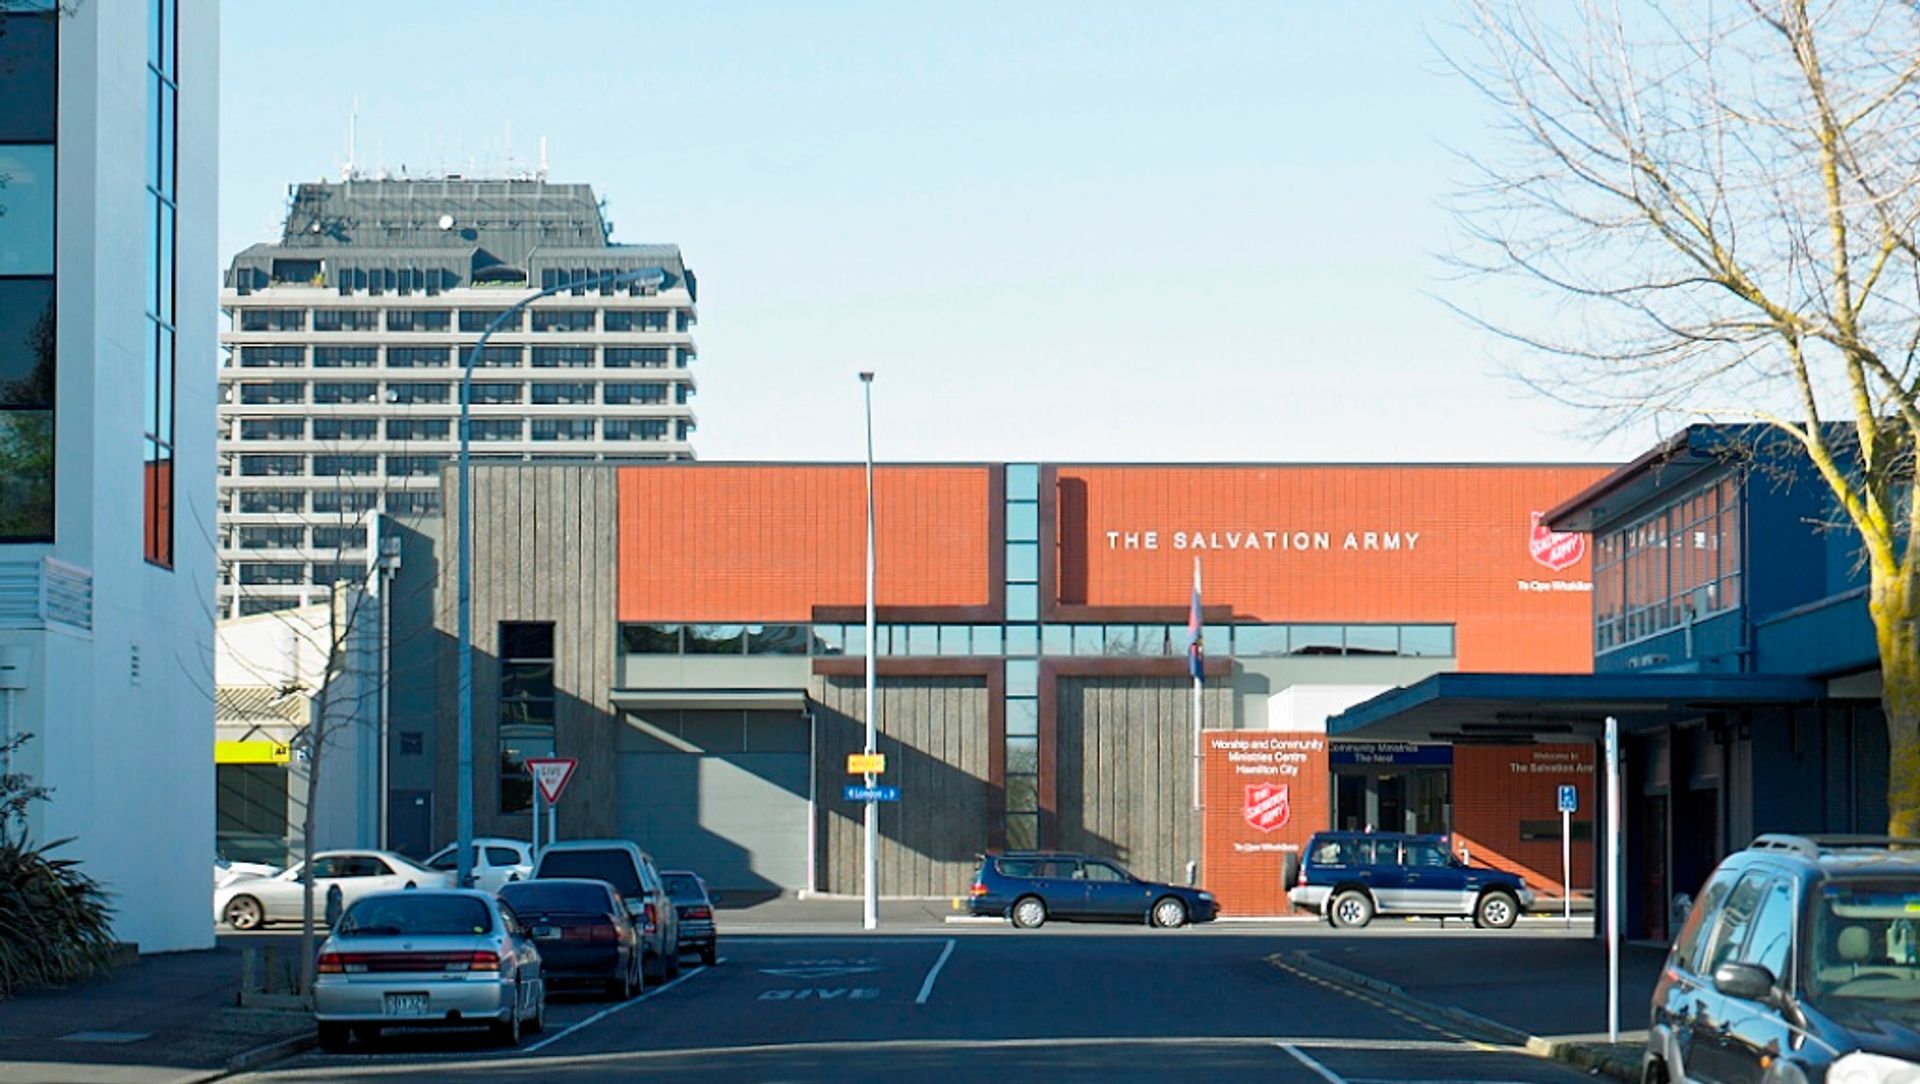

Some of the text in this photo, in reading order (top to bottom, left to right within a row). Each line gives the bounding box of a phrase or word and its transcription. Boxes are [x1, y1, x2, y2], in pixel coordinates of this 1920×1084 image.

[1107, 531, 1421, 550] THE SALVATION ARMY
[1211, 738, 1323, 752] Worship and Community
[1228, 751, 1307, 762] Ministries Centre
[1236, 764, 1298, 777] Hamilton City
